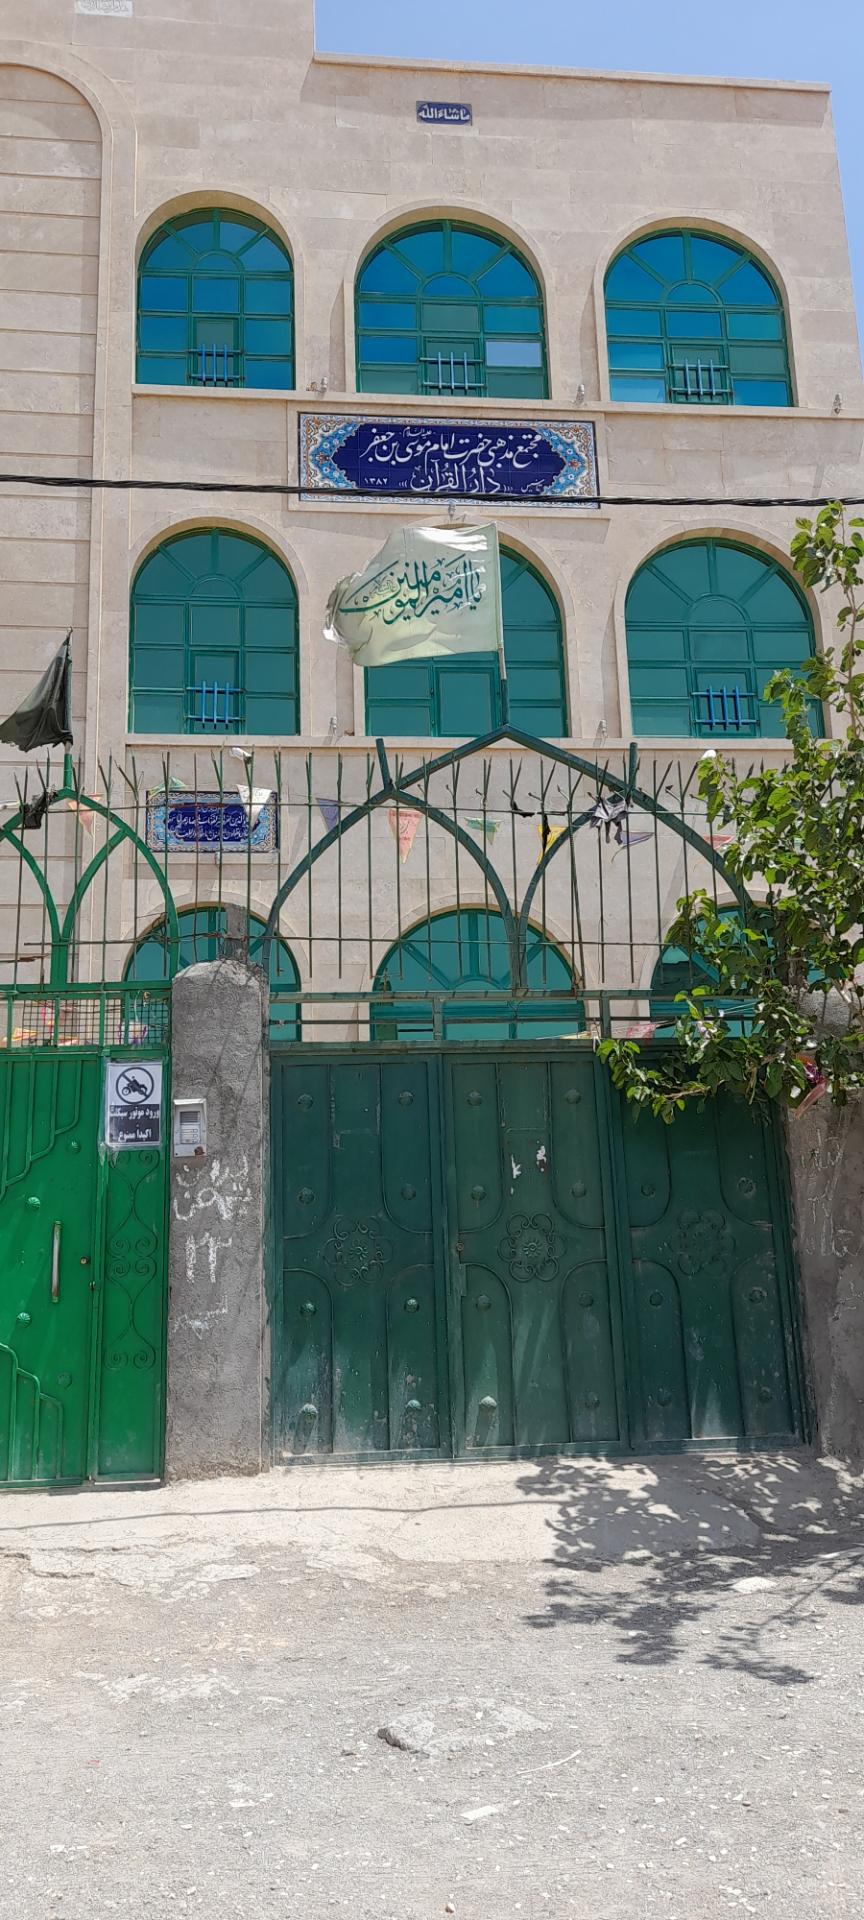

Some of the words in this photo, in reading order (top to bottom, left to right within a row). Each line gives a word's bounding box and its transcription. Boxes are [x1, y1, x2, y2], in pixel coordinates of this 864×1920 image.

[359, 428, 395, 463] جعفر
[375, 441, 399, 465] بن
[395, 439, 430, 462] موسی
[444, 433, 492, 466] حضرت
[477, 435, 513, 468] مذهبی
[513, 434, 542, 468] مجتمع
[145, 1108, 159, 1119] ورود
[118, 1130, 135, 1142] ممنوع
